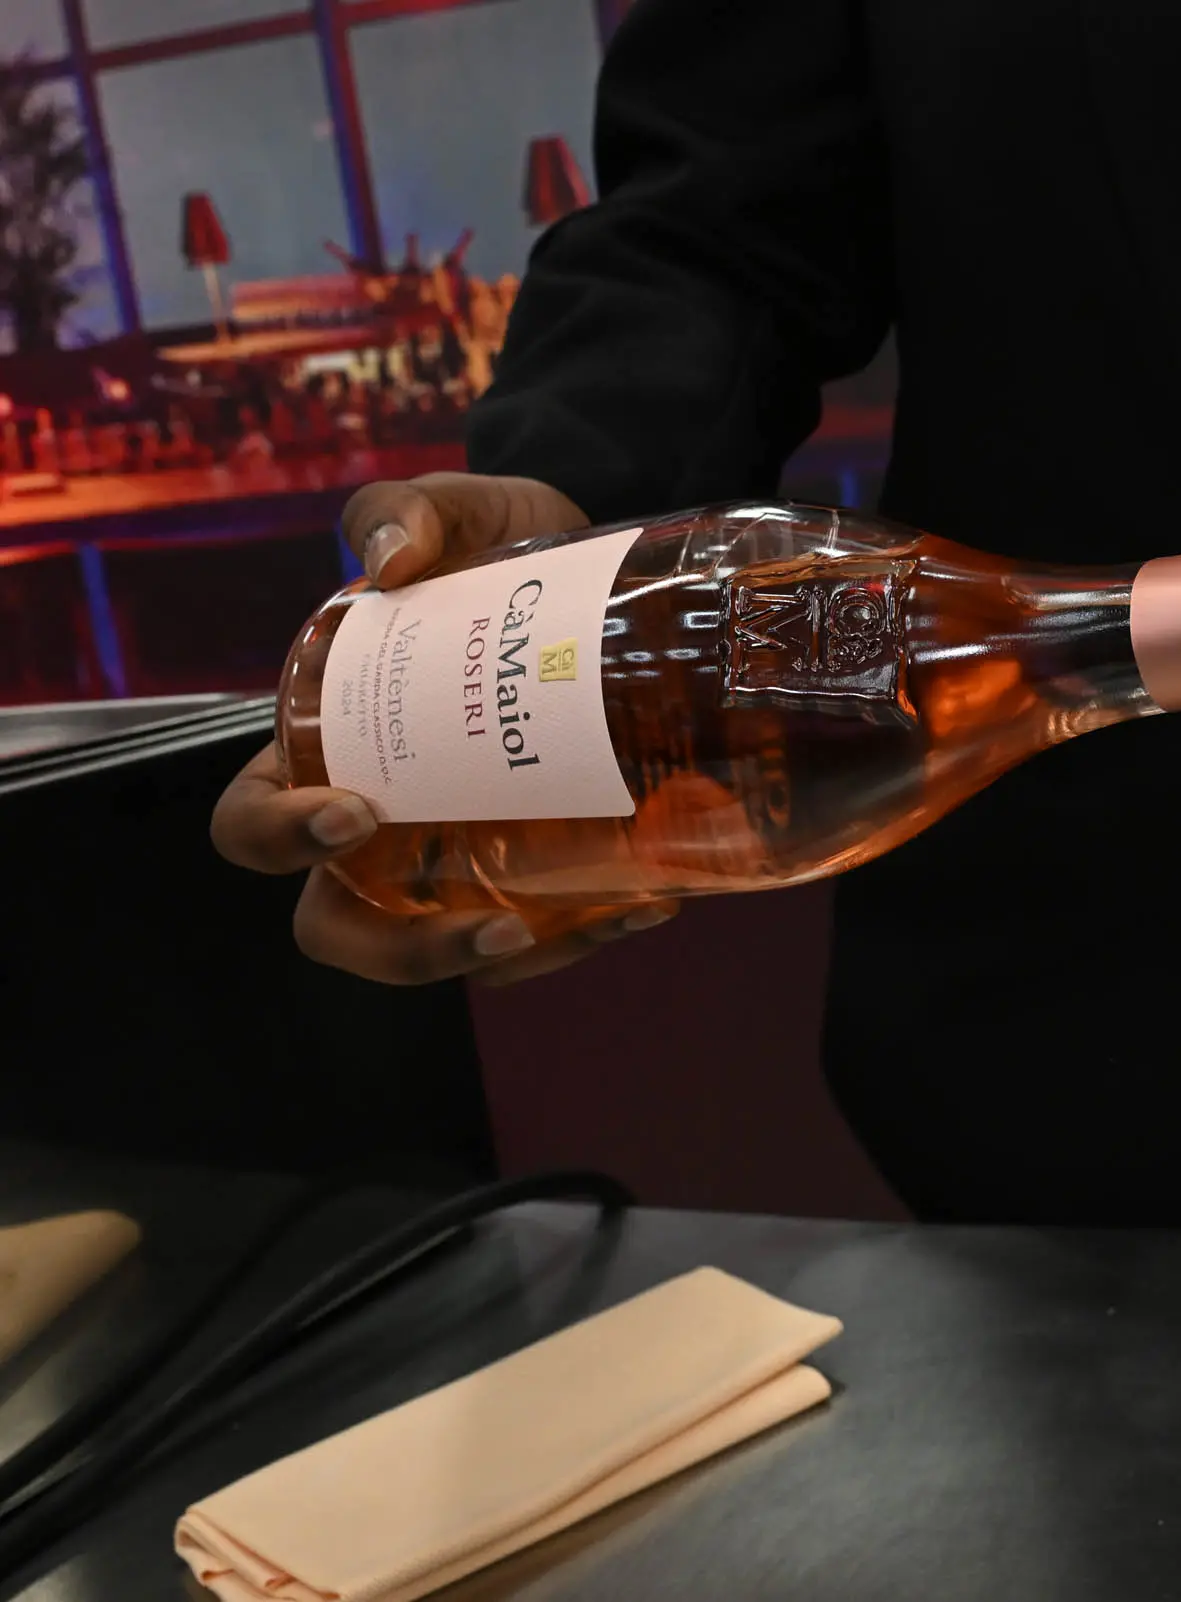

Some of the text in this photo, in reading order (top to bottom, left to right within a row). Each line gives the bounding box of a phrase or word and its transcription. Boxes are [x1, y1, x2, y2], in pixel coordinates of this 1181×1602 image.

[387, 618, 422, 762] Valtènesi
[463, 616, 491, 737] ROSERI
[496, 579, 543, 771] CàMaiol
[541, 651, 557, 675] M
[372, 702, 384, 755] CLASSICO
